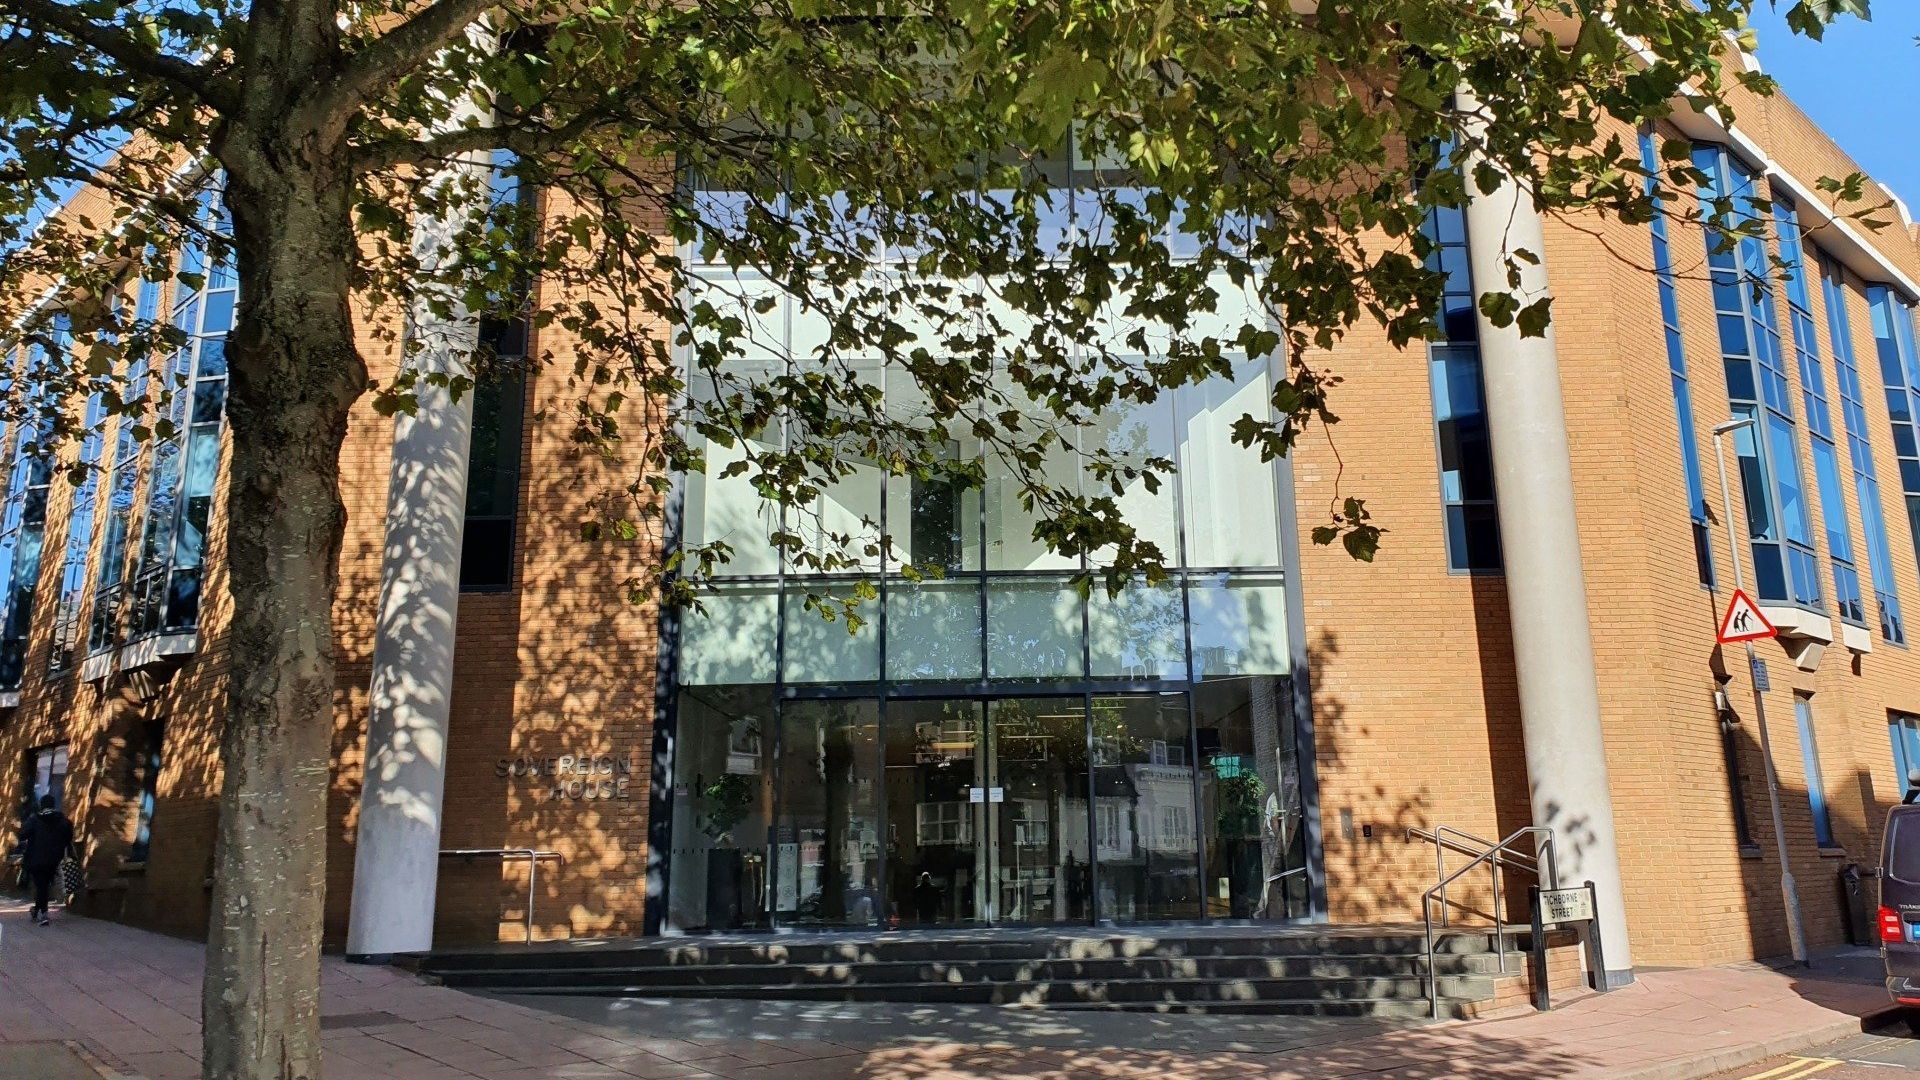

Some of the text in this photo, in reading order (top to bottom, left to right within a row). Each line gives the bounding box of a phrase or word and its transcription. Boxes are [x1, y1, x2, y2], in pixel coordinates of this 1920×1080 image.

[495, 755, 631, 776] SOVEREIGN
[549, 777, 630, 799] HOUSE
[1543, 892, 1577, 905] TICHBORNE
[1552, 907, 1573, 919] STREET
